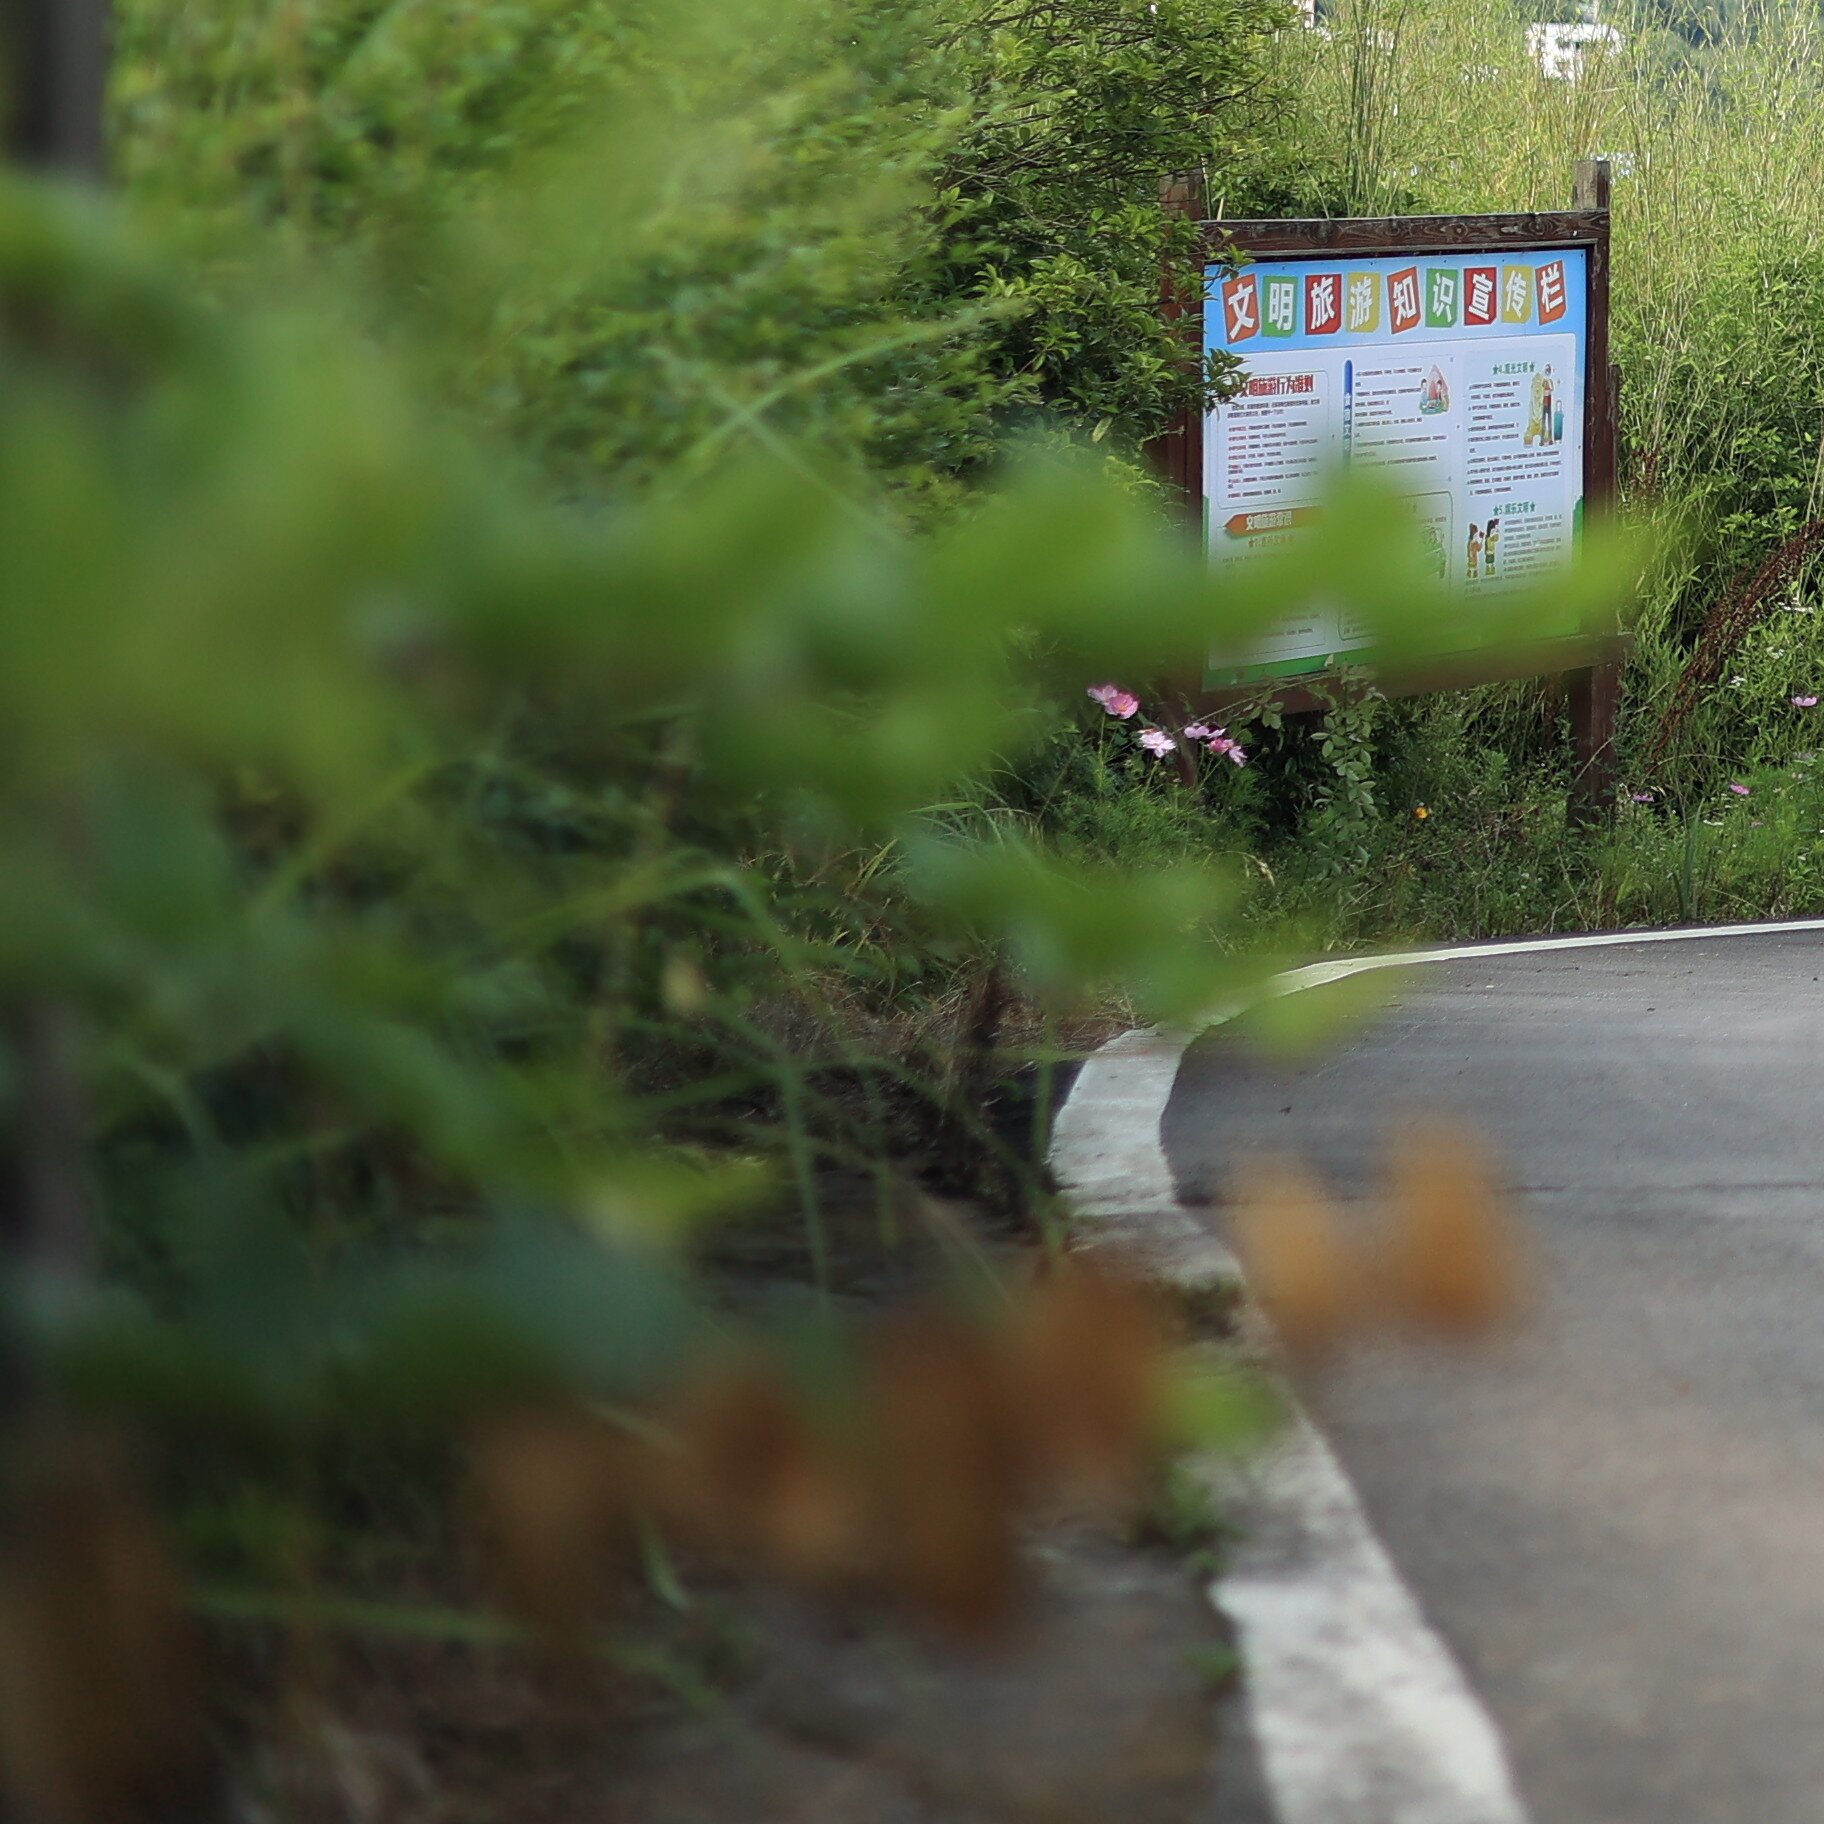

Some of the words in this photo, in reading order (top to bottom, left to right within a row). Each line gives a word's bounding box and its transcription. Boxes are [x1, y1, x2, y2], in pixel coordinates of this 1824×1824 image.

[1227, 264, 1564, 338] 文明旅游知识宣传栏
